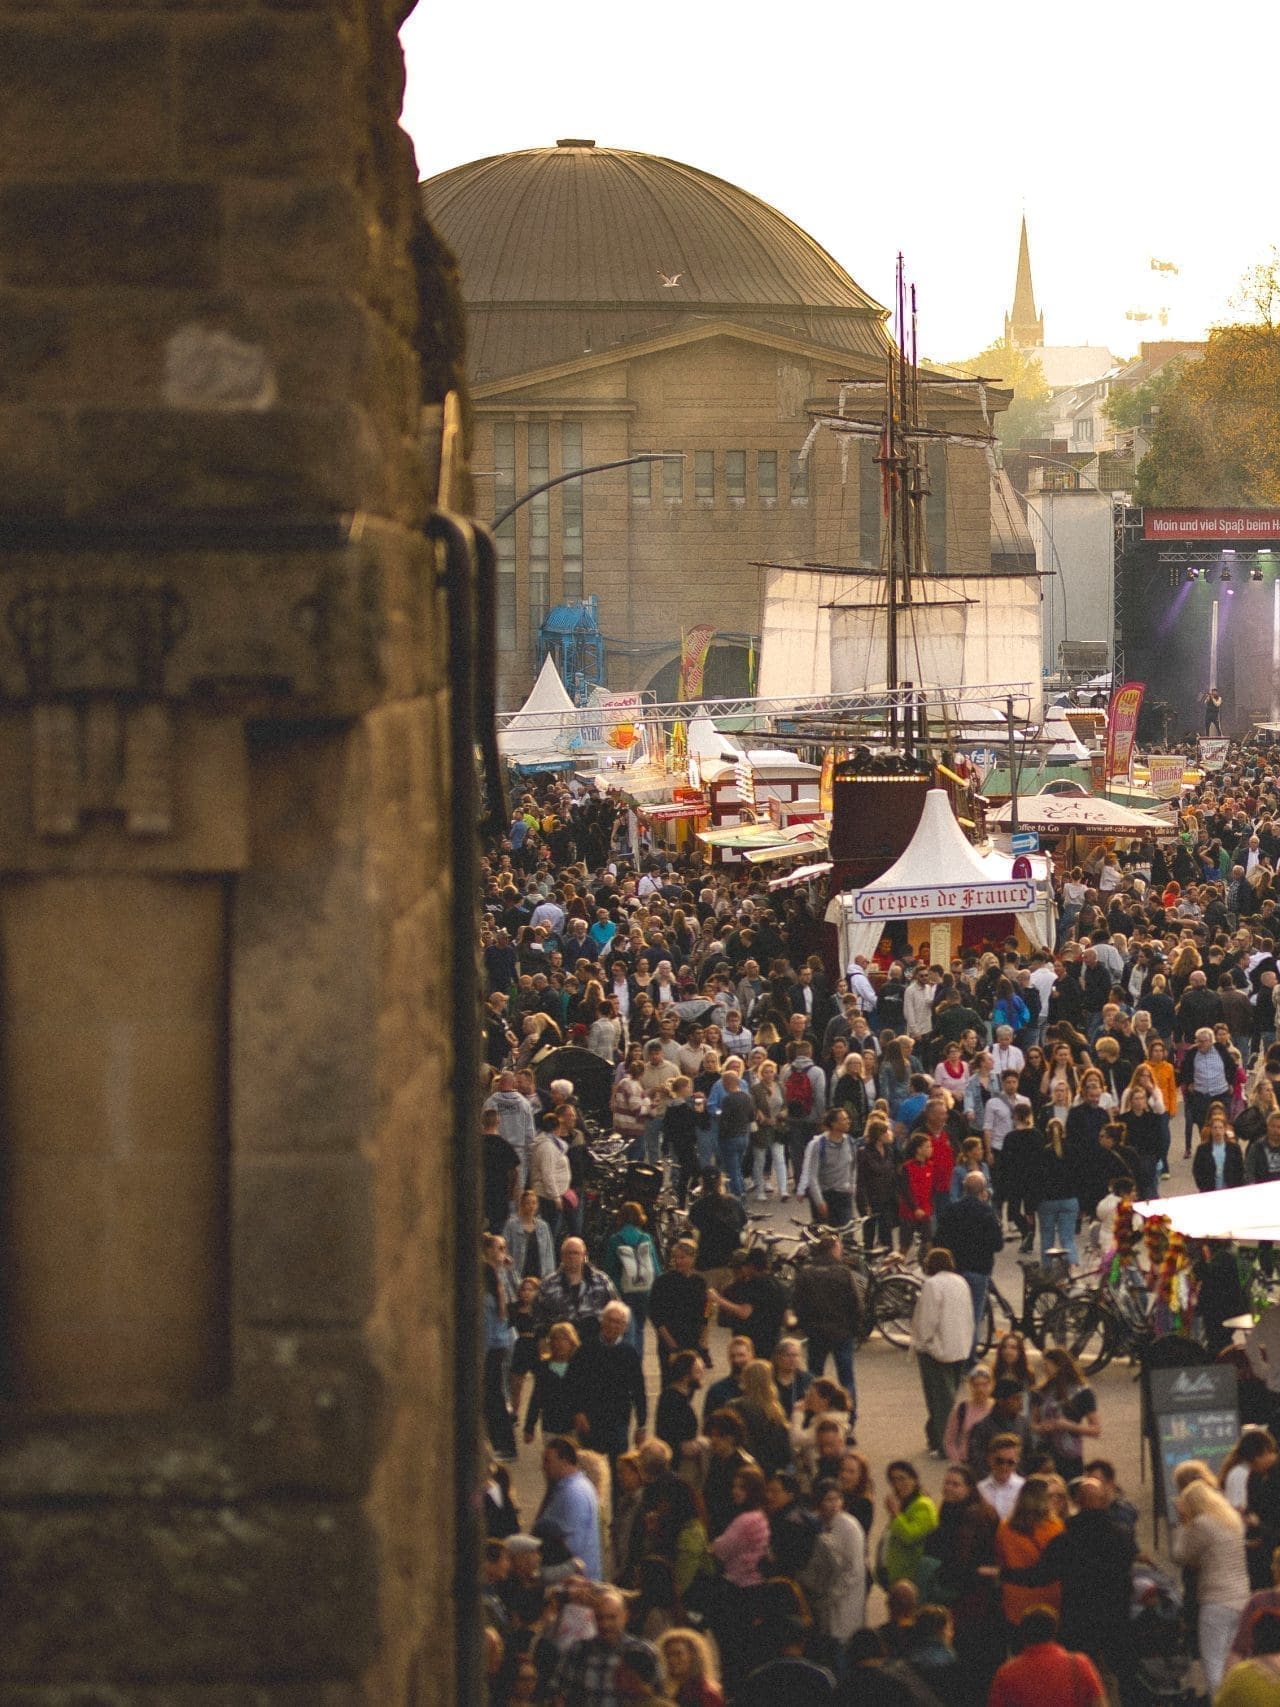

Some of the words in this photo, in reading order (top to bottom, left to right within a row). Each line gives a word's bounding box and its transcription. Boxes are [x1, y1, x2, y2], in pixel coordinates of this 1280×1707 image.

[1153, 519, 1178, 531] Moin
[1180, 519, 1198, 531] und
[1200, 519, 1217, 531] viel
[1219, 519, 1245, 533] Spaß
[1246, 519, 1270, 531] beim
[1017, 823, 1037, 832] offee
[1037, 824, 1046, 832] to
[1047, 824, 1060, 832] Go
[861, 894, 931, 916] Crêpes
[937, 889, 957, 907] de
[960, 887, 1029, 910] France
